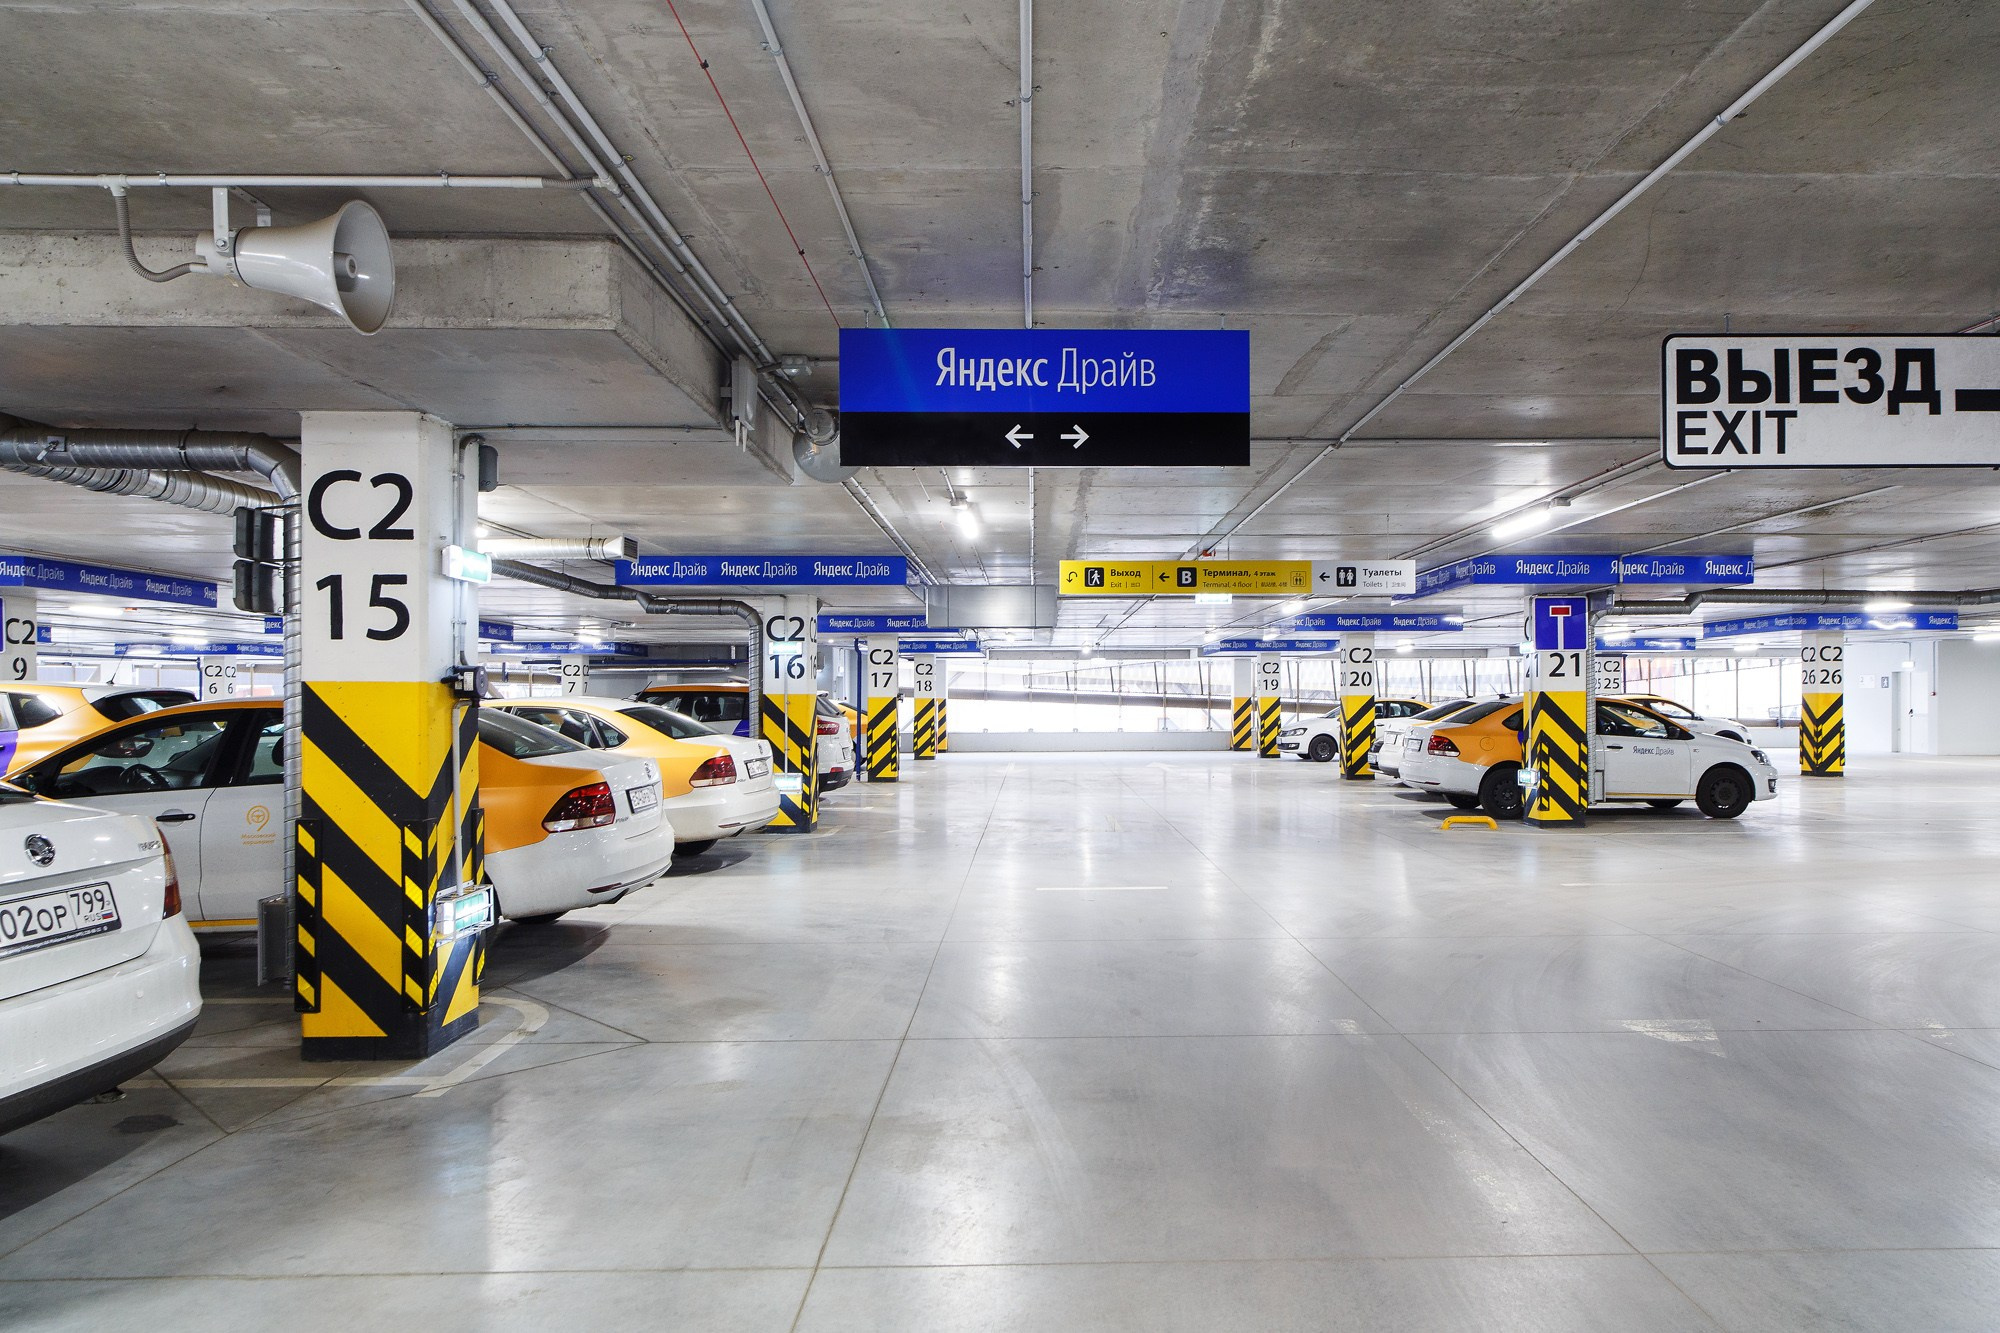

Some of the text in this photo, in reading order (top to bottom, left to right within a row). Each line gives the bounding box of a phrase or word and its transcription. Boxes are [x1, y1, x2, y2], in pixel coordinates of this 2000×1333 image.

[936, 347, 1156, 394] Яндекс Драйв
[1676, 347, 1941, 415] ВЫЕЗД
[1677, 410, 1798, 455] EXIT
[308, 469, 414, 540] C2
[630, 561, 890, 578] Яндекс Драйв Яндекс Драйв Яндекс Драйв
[1110, 569, 1142, 578] Выход
[1203, 569, 1251, 578] Терминал,
[1363, 568, 1402, 578] Туалеты
[1516, 560, 1554, 575] Яндекс
[1556, 560, 1590, 577] Драйв
[1651, 561, 1685, 577] Драйв
[1705, 561, 1743, 575] Яндекс
[0, 561, 36, 577] Яндекс
[37, 564, 65, 581] Драйв
[80, 569, 108, 587] Яндекс
[109, 573, 133, 590] Драйв
[145, 578, 170, 595] Яндекс
[171, 582, 193, 598] Драйв
[316, 574, 411, 640] 15
[829, 618, 853, 628] Яндекс
[853, 618, 875, 628] Драйв
[886, 618, 910, 628] Яндекс
[1305, 617, 1326, 627] Драйв
[1337, 617, 1360, 626] Яндекс
[1361, 617, 1381, 627] Драйв
[1393, 617, 1416, 626] Яндекс
[1417, 617, 1438, 627] Драйв
[1818, 616, 1840, 625] Яндекс
[1929, 616, 1951, 625] Яндекс
[6, 618, 36, 645] C2
[766, 615, 805, 642] C2
[869, 649, 894, 665] C2
[1349, 648, 1372, 663] C2
[1801, 647, 1816, 662] C2
[1820, 646, 1842, 661] C2
[13, 657, 27, 680] 9
[204, 665, 222, 677] C2
[225, 666, 236, 677] C2
[563, 664, 580, 676] C2
[769, 655, 805, 679] 16
[915, 663, 933, 675] C2
[1262, 662, 1280, 674] C2
[1549, 653, 1580, 677] 21
[1604, 661, 1620, 673] C2
[871, 672, 893, 687] 17
[1350, 671, 1372, 686] 20
[1604, 678, 1619, 689] 25
[1802, 669, 1815, 684] 26
[1820, 669, 1842, 684] 26
[209, 683, 217, 694] 6
[228, 683, 233, 694] 6
[568, 682, 576, 693] 7
[916, 680, 932, 691] 18
[1263, 679, 1278, 690] 19
[1633, 746, 1654, 754] Яндекс
[70, 889, 105, 915] 799
[84, 912, 101, 923] RUS
